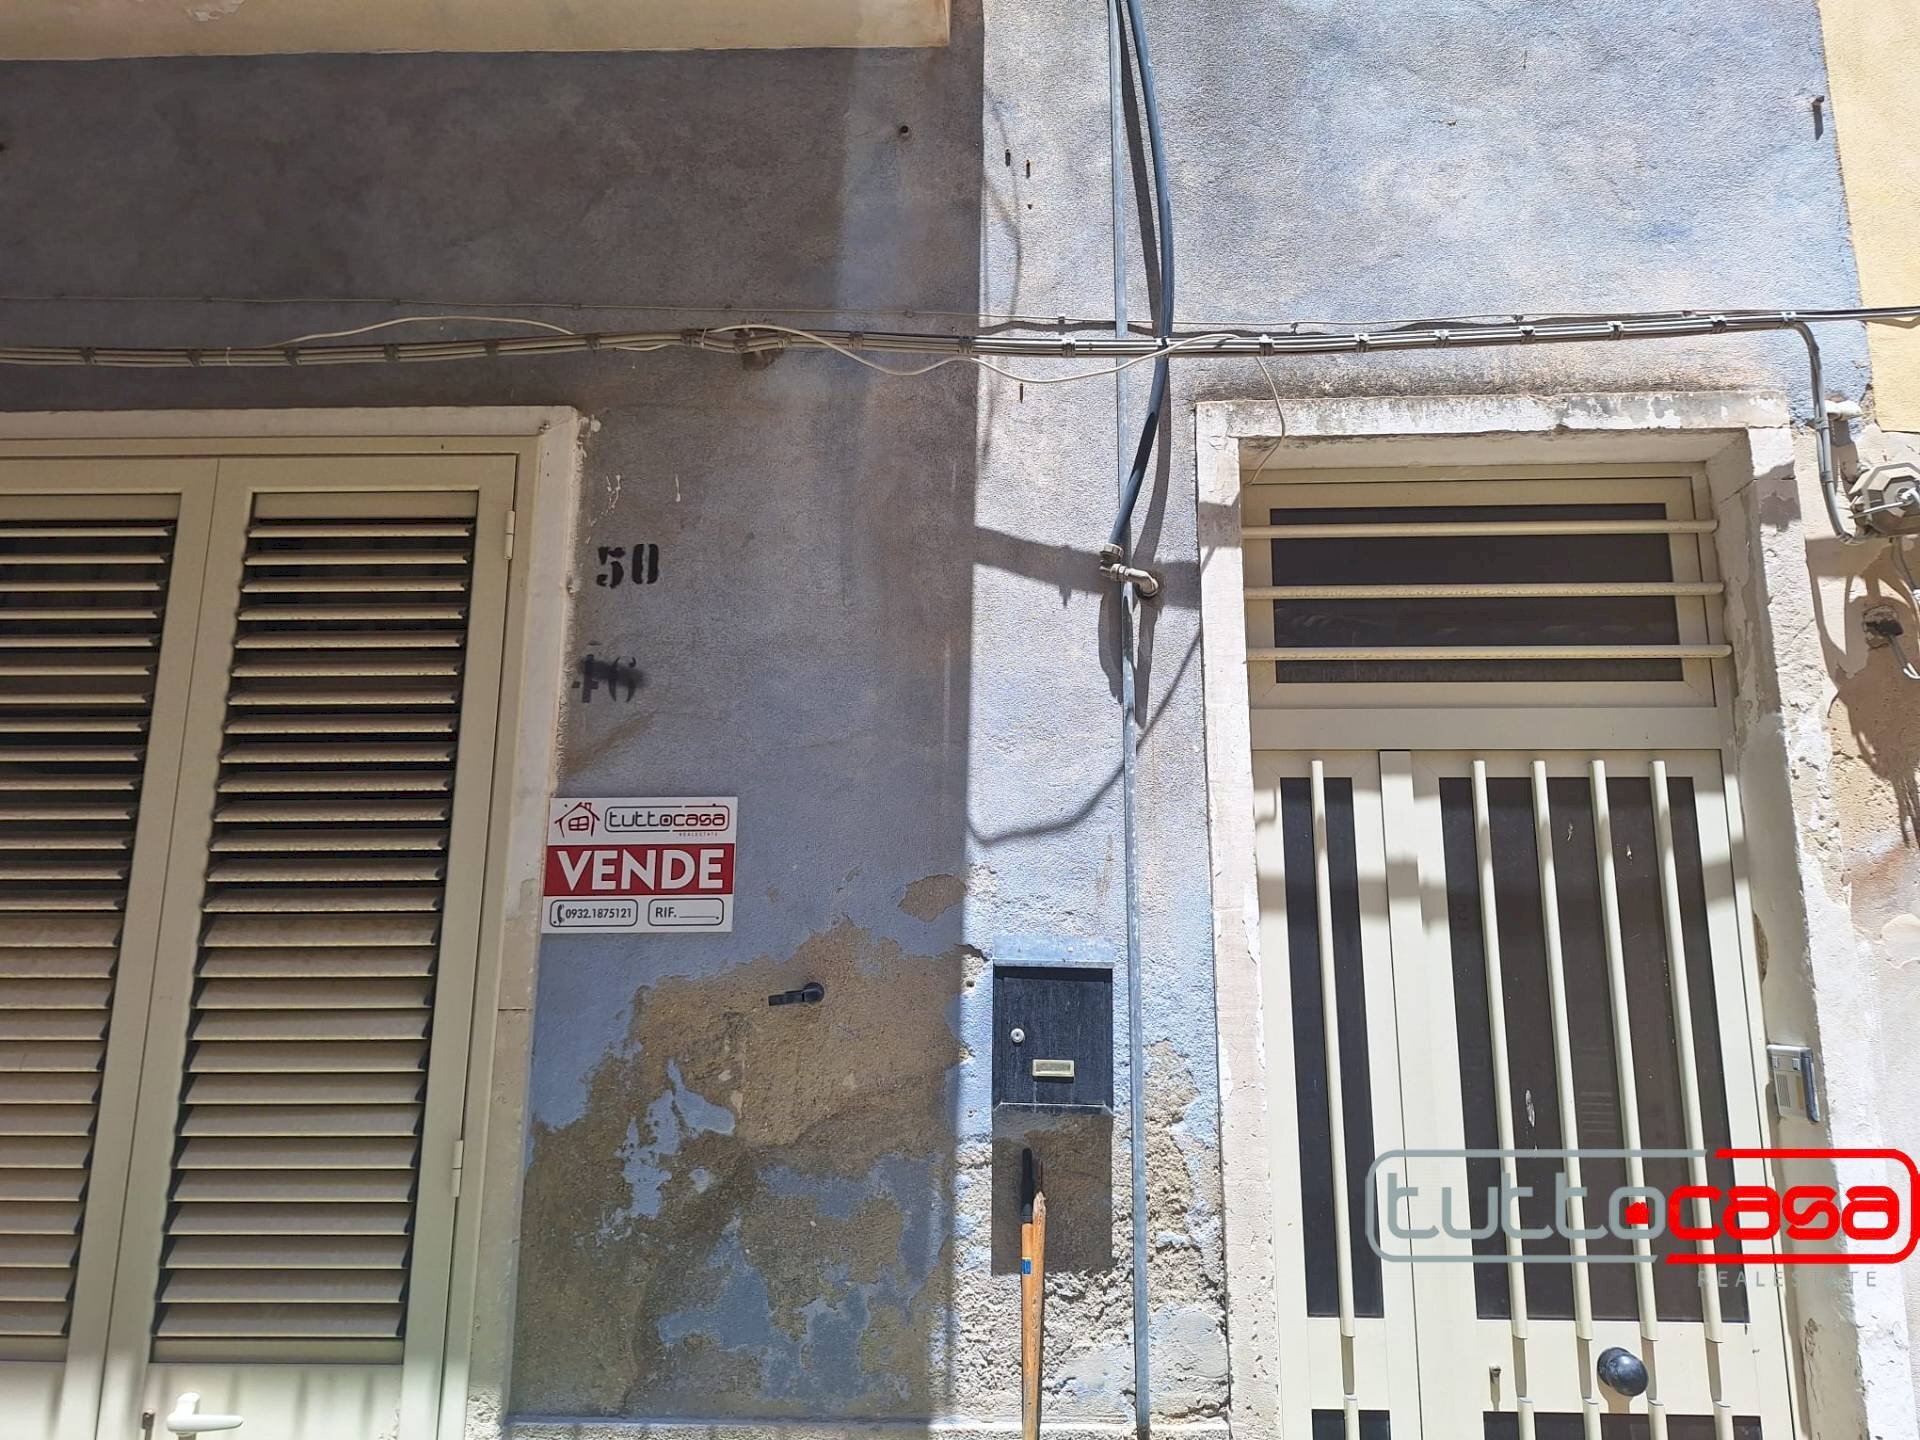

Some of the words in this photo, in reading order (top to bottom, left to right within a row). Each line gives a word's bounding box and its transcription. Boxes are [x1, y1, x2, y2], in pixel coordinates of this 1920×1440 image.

[596, 543, 659, 589] 50
[609, 811, 726, 828] tuttocasa
[556, 849, 725, 891] VENDE
[565, 907, 632, 919] 0932.1875121
[655, 907, 677, 918] RIF.
